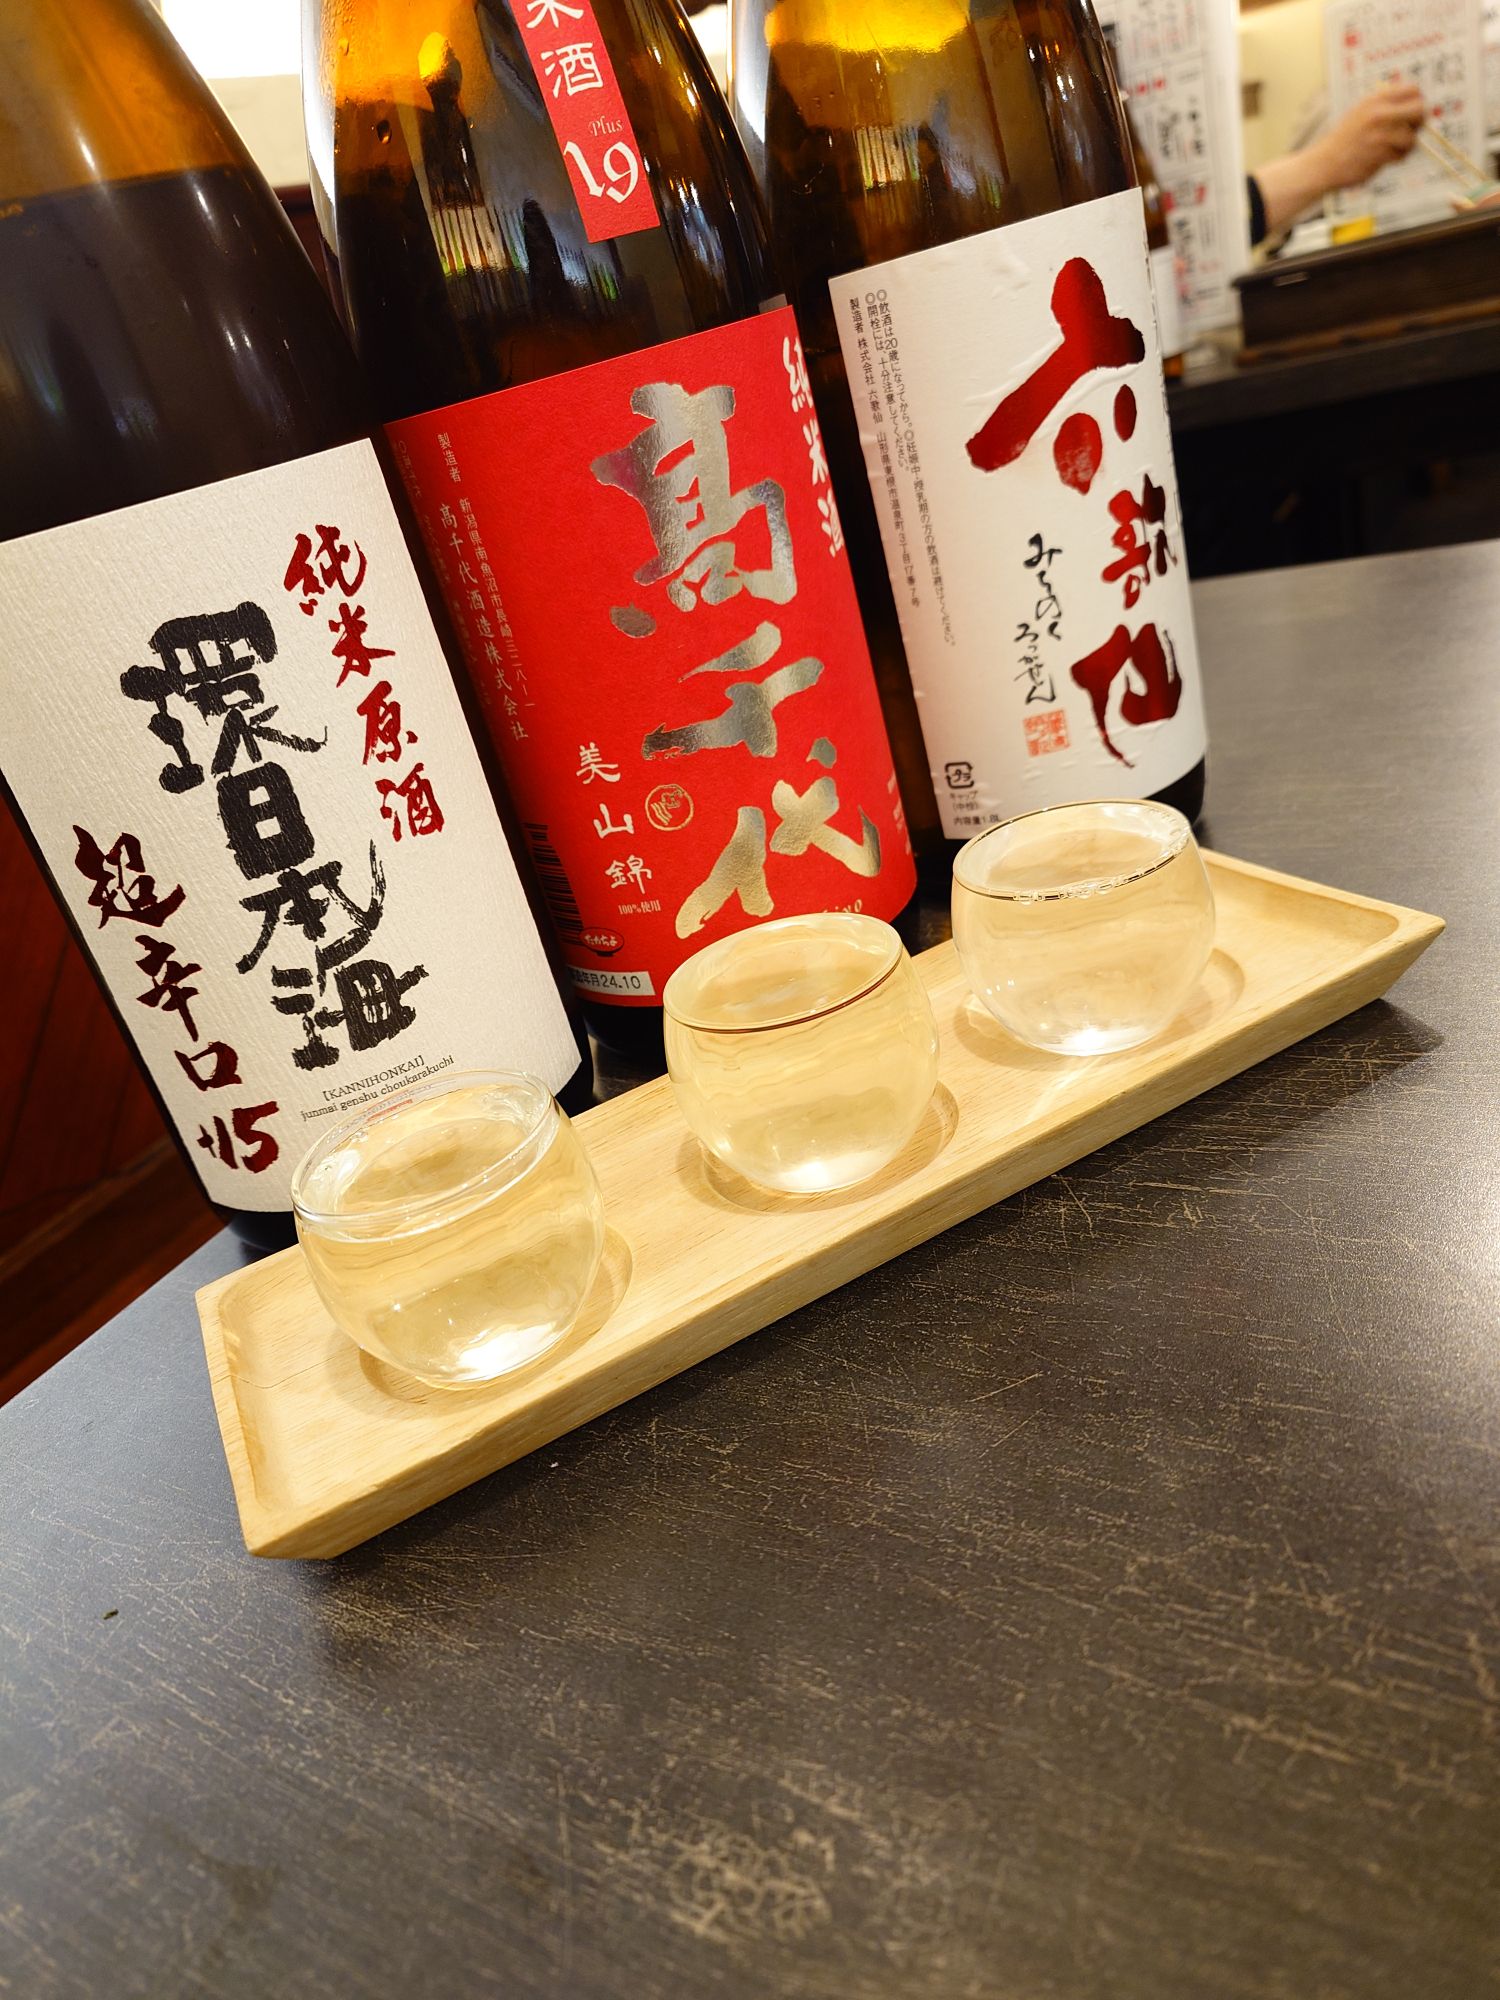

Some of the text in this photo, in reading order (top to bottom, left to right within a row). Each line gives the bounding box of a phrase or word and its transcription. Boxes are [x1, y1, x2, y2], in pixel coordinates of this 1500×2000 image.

[588, 116, 624, 137] Plus
[563, 141, 639, 203] 19
[438, 431, 461, 484] 製造者
[965, 256, 1183, 769] 六歌仙
[284, 524, 444, 843] 純米原酒
[119, 600, 430, 1072] 環日本海
[575, 741, 654, 895] 美山錦
[618, 899, 662, 916] 100%使用
[300, 1054, 455, 1122] junmai genshu choukarakuchi
